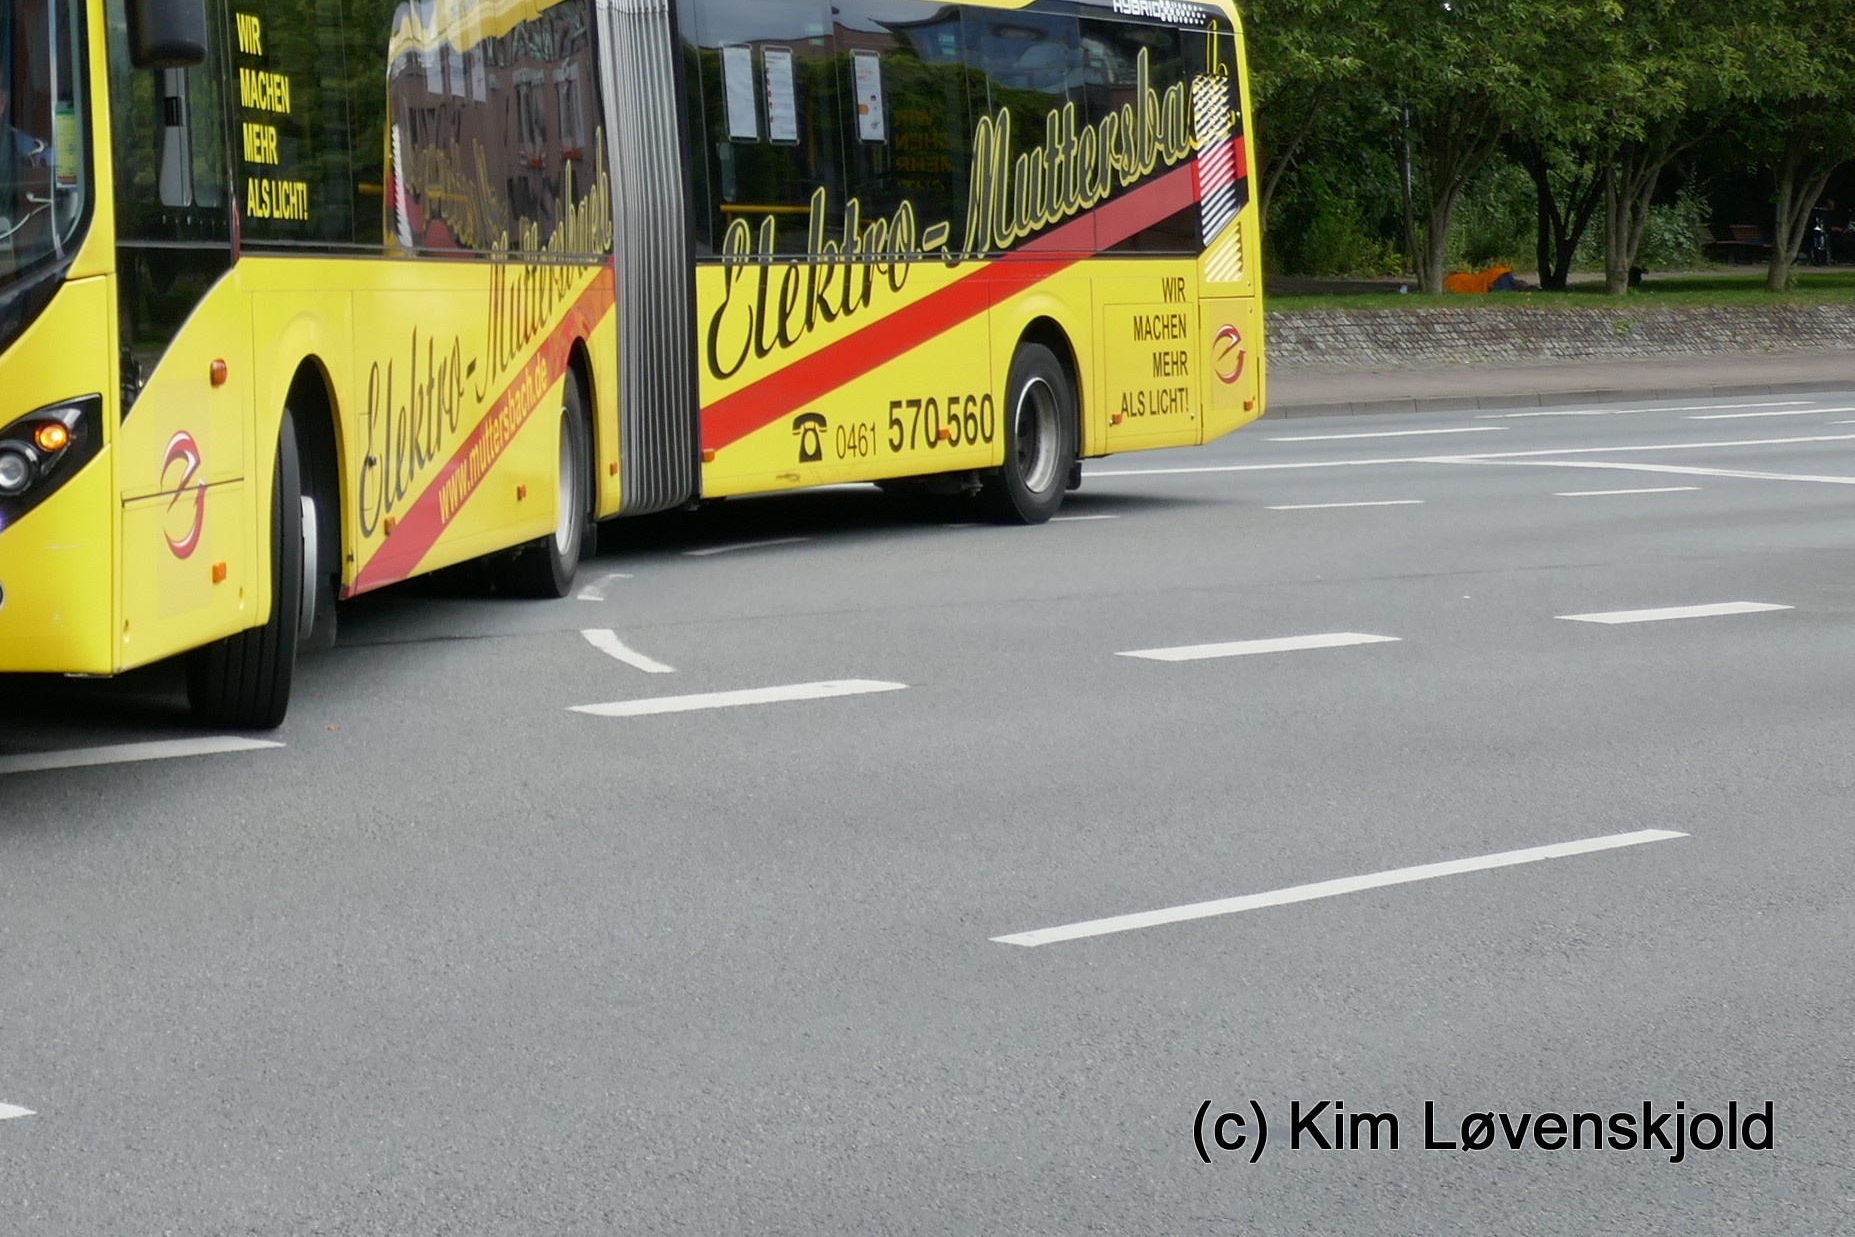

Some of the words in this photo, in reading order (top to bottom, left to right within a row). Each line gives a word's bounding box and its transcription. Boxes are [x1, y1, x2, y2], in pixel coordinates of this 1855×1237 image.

[236, 13, 262, 56] WIR
[239, 68, 290, 113] MACHEN
[243, 122, 278, 165] MEHR
[247, 177, 271, 218] ALS
[271, 179, 308, 220] LICHT!
[1162, 277, 1186, 303] WIR
[1133, 314, 1187, 341] MACHEN
[1153, 351, 1188, 378] MEHR
[1121, 391, 1145, 418] ALS
[1149, 387, 1189, 415] LICHT!
[438, 353, 548, 525] www.muttersbach.de
[835, 421, 877, 459] 0461
